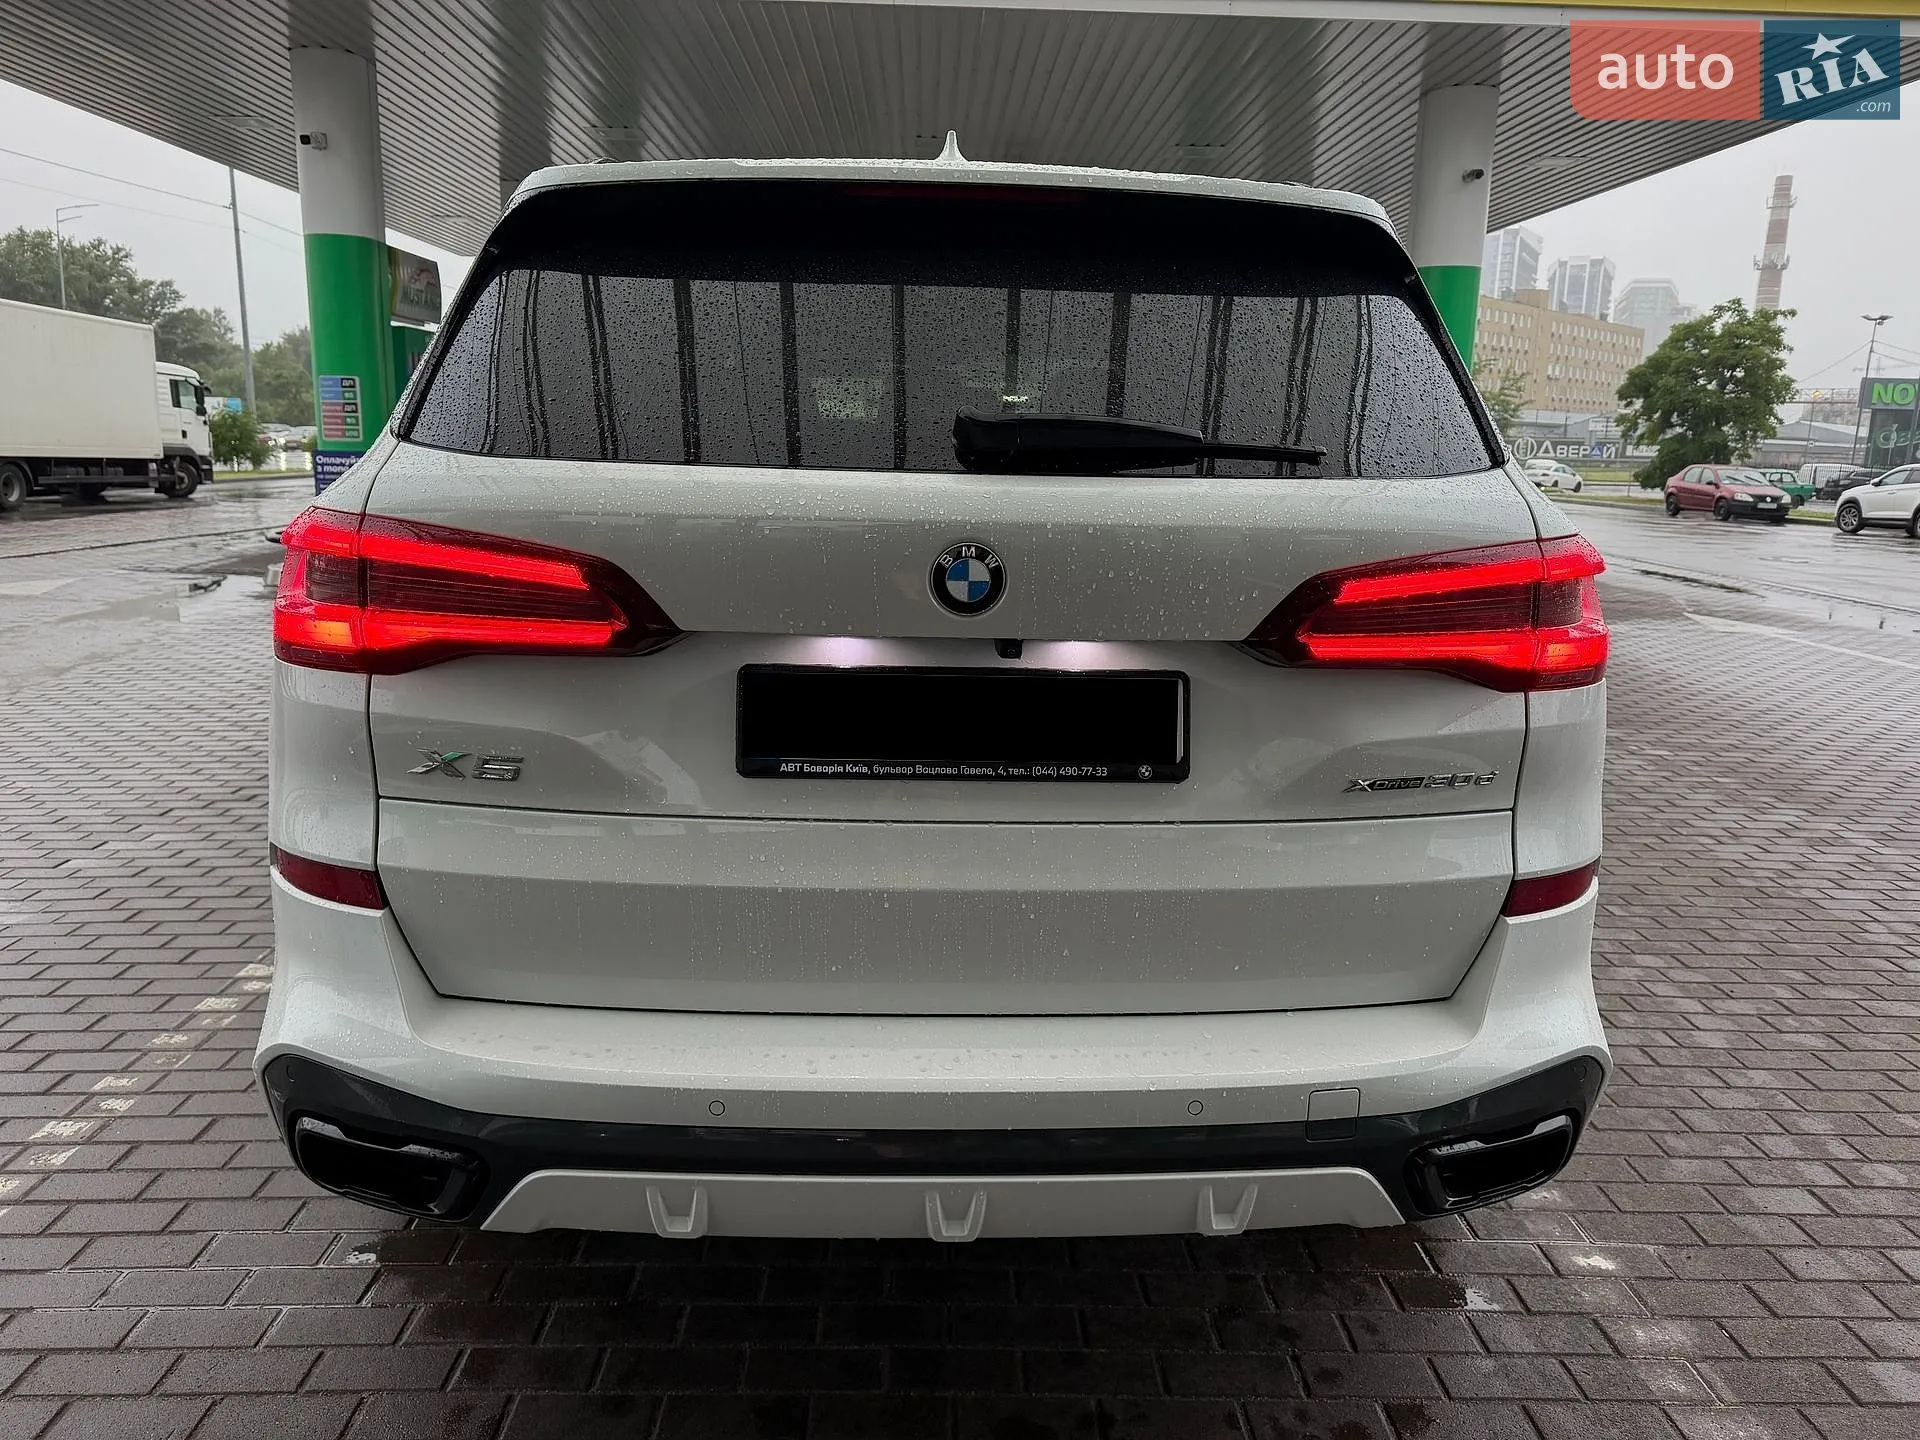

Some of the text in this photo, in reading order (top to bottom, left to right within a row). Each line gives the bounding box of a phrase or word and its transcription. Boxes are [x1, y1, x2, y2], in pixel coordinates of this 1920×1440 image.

[1871, 382, 1919, 405] NO
[939, 546, 999, 568] BMW
[407, 747, 524, 781] X5
[779, 763, 1108, 777] АВТ Баварія Київ, бульвар Вацлава Гавела, 4, тел.: (044) 490-77-33
